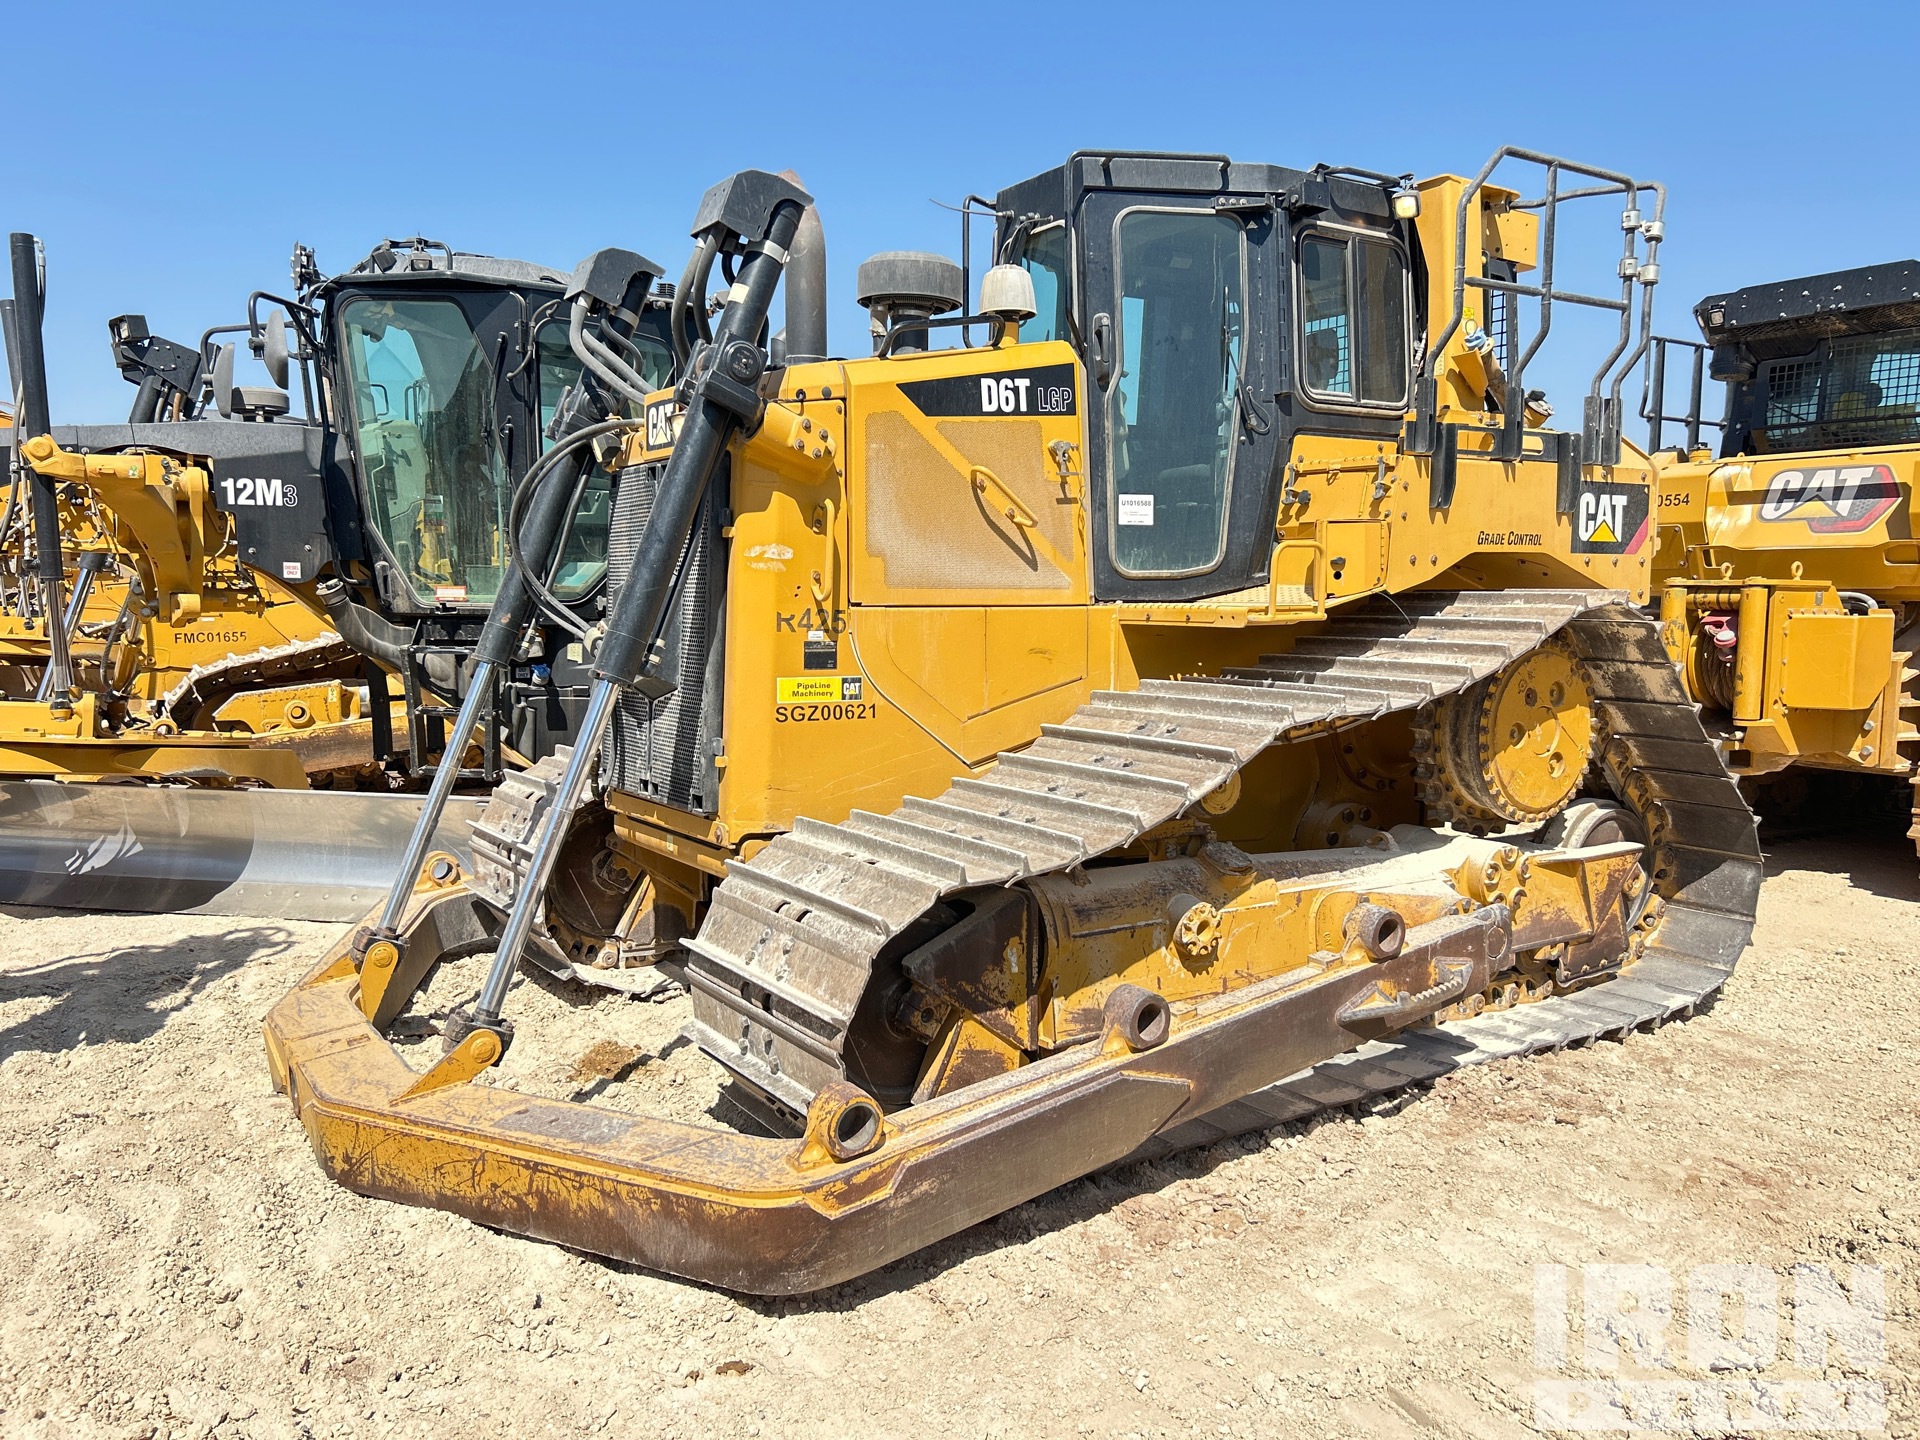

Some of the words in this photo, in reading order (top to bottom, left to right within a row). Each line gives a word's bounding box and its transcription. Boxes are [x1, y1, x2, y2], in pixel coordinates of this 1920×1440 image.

[981, 377, 1031, 413] D6T
[1037, 387, 1073, 412] LGP
[648, 402, 675, 446] CAT
[220, 477, 298, 507] 12M3
[1761, 466, 1875, 520] CAT
[1578, 492, 1628, 543] CAT
[174, 631, 247, 644] FMC01655
[792, 690, 834, 698] Machinery
[797, 682, 831, 690] PipeLine
[843, 682, 861, 695] CAT
[775, 703, 876, 723] SGZ00621
